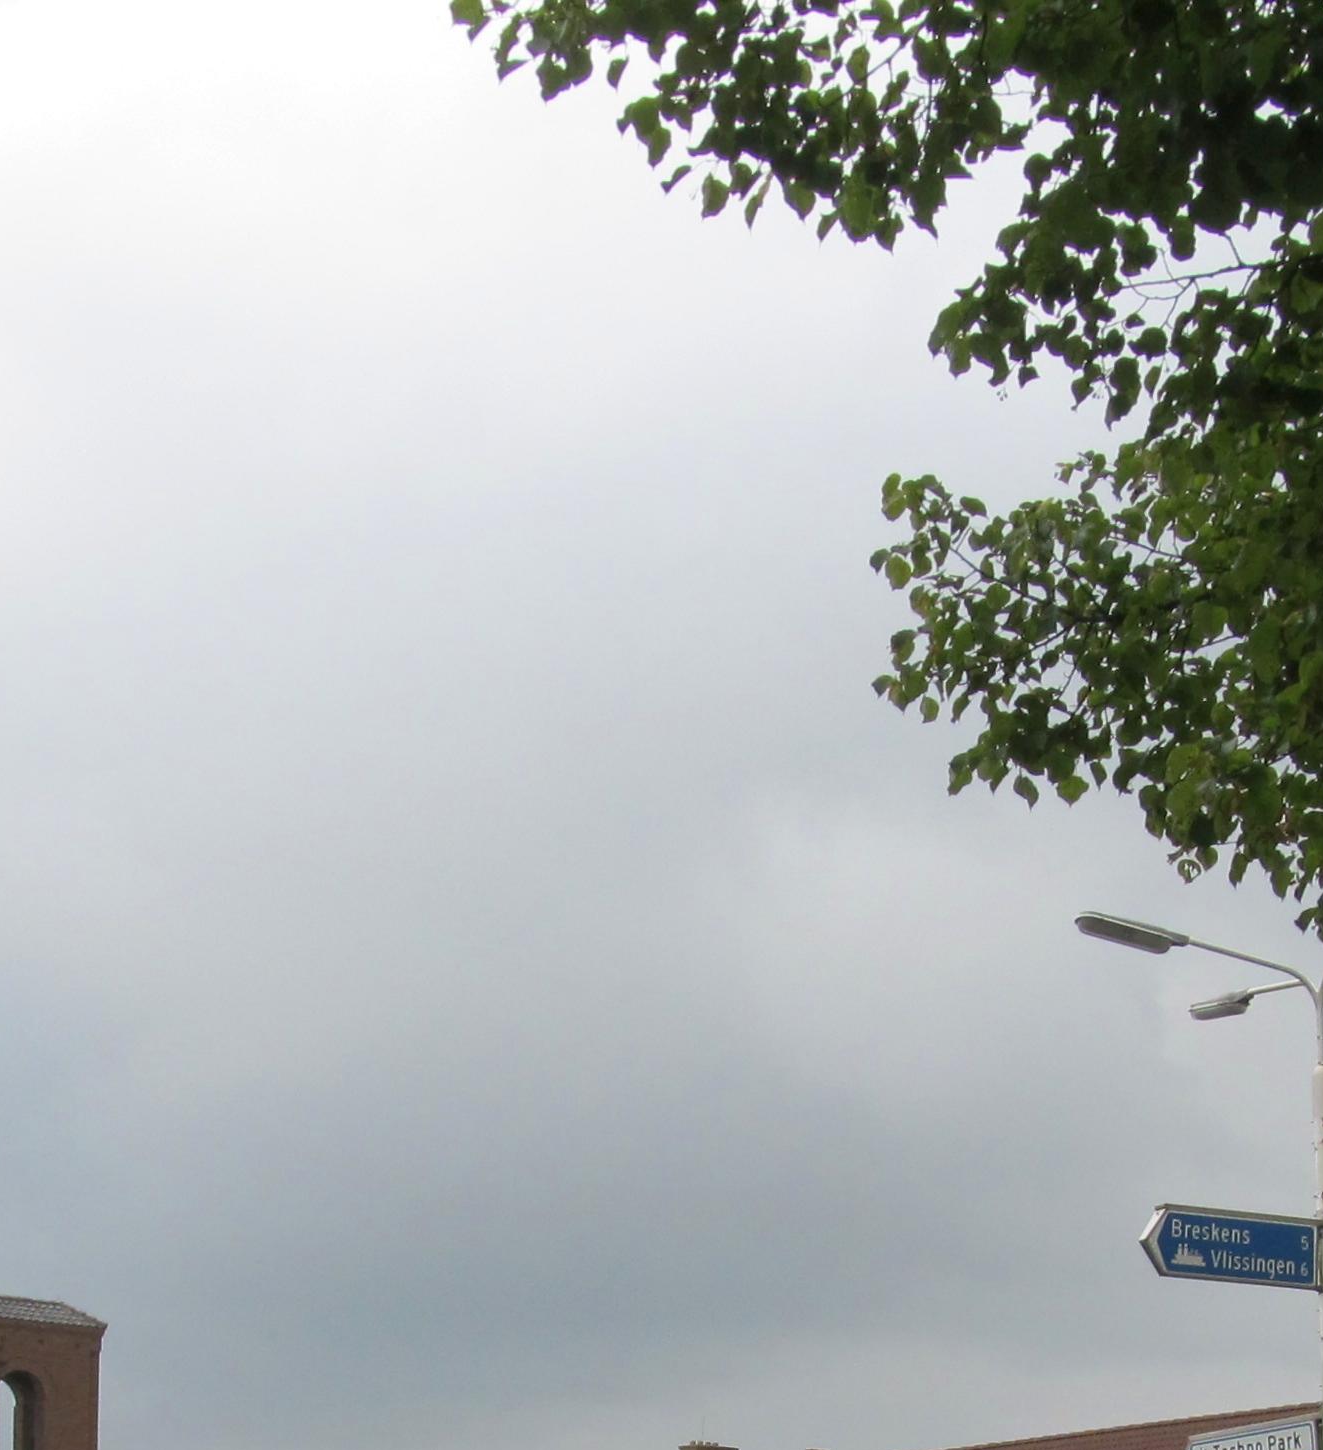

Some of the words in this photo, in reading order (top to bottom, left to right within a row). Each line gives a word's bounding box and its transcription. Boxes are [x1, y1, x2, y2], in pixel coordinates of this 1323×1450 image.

[1171, 1219, 1250, 1245] Breskens
[1301, 1236, 1309, 1250] 5
[1211, 1250, 1295, 1279] Vlissingen
[1300, 1263, 1309, 1277] 6
